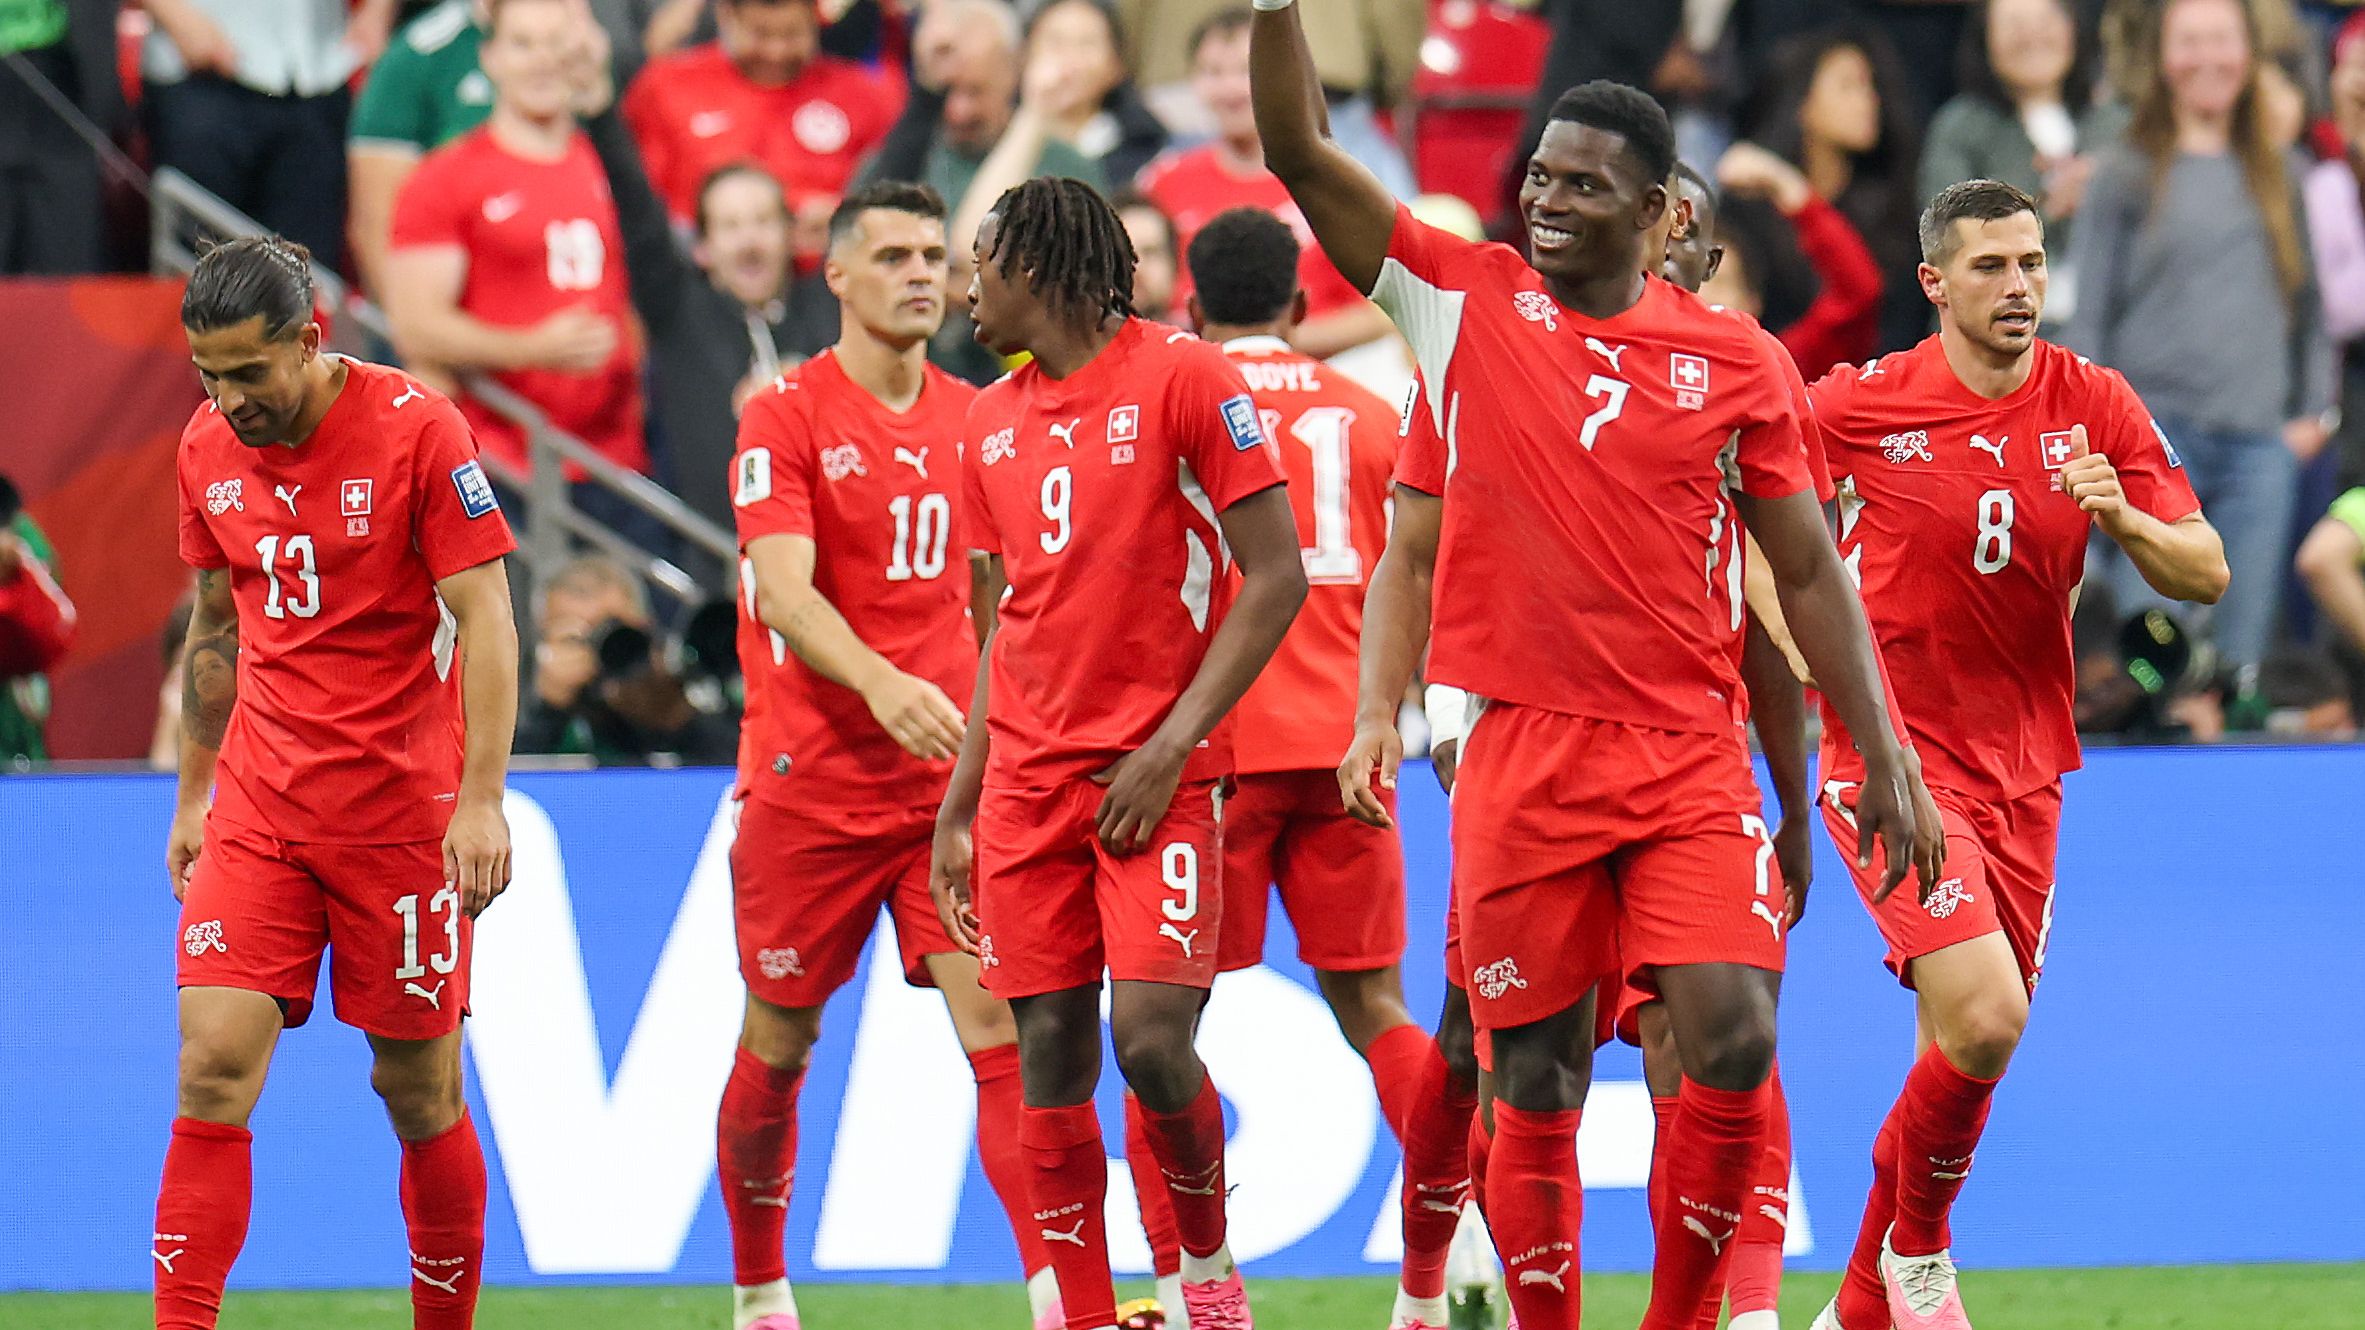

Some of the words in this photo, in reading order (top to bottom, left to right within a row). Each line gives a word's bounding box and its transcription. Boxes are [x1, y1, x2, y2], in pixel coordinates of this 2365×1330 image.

[1579, 374, 1631, 451] 7
[886, 493, 950, 581] 10
[1040, 465, 1072, 555] 9
[1258, 406, 1364, 584] 1
[1974, 490, 2014, 575] 8
[255, 535, 320, 619] 13
[1162, 842, 1198, 921] 9
[1740, 813, 1775, 896] 7
[392, 888, 459, 979] 13
